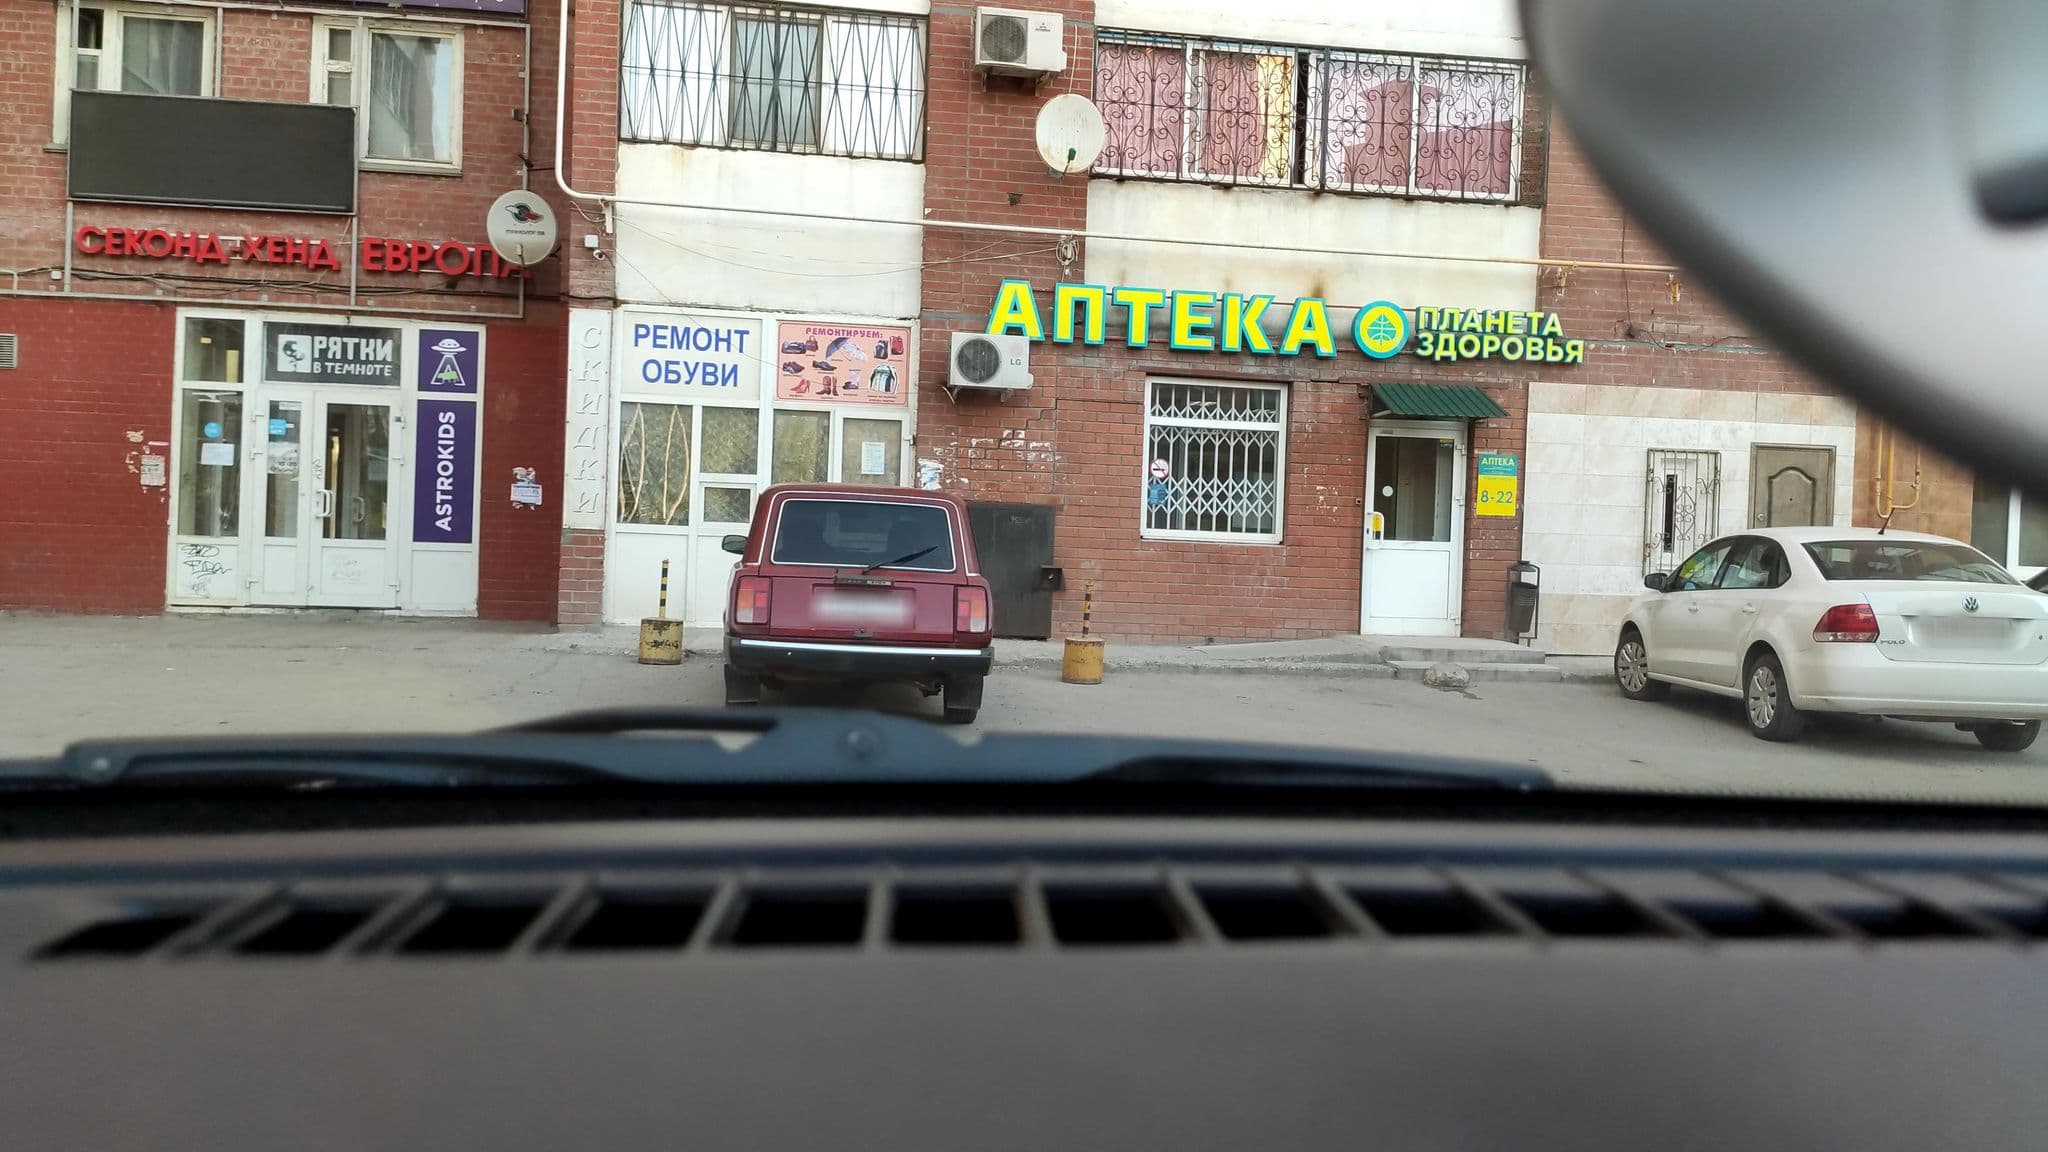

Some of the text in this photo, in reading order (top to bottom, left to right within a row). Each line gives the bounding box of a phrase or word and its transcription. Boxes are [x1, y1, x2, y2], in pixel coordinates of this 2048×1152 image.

[76, 225, 341, 271] СЕКОНД-ХЕНД
[805, 327, 883, 339] РЕМОНТИРУЕМ:
[985, 278, 1338, 358] АПТЕКА
[1416, 306, 1563, 337] ПЛАНЕТА
[634, 323, 750, 353] РЕМОНТ
[1416, 332, 1584, 363] ЗДОРОВЬЯ
[313, 361, 393, 376] В ТЕМНОТЕ
[642, 359, 738, 387] ОБУВИ
[1010, 358, 1021, 366] LG
[573, 327, 602, 514] СКИДКИ
[435, 411, 456, 532] ASTROKIDS
[1481, 457, 1515, 466] АПТЕКА
